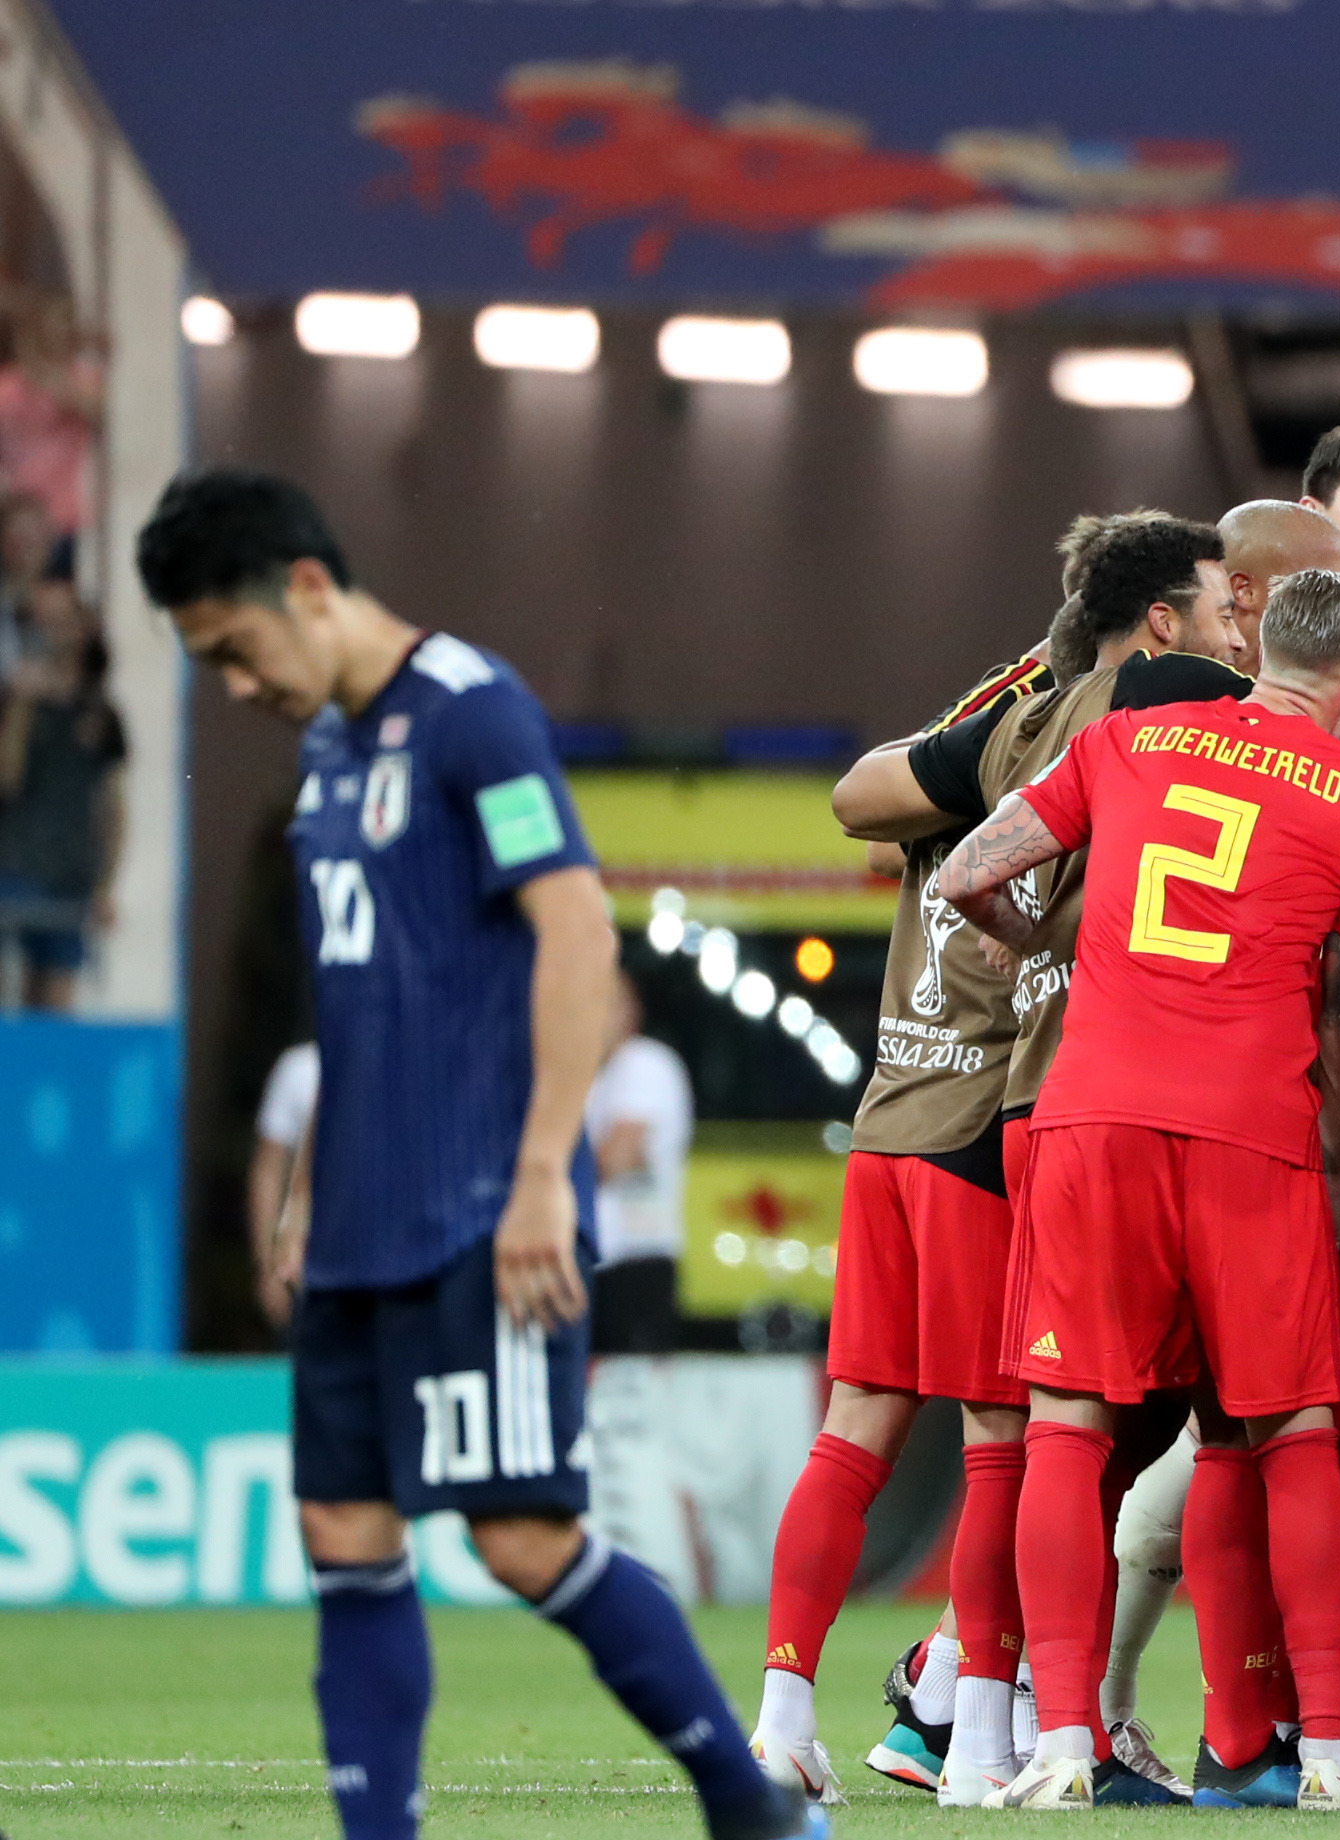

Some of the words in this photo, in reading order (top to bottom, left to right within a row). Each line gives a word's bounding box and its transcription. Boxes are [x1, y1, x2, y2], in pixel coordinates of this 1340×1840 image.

[1128, 783, 1262, 963] 2
[310, 857, 376, 966] 10
[1030, 949, 1052, 969] CUP
[1032, 960, 1077, 1003] 201
[896, 1019, 938, 1040] WORLD
[938, 1027, 960, 1041] CUP
[920, 1042, 984, 1074] 2018
[413, 1368, 494, 1486] 10
